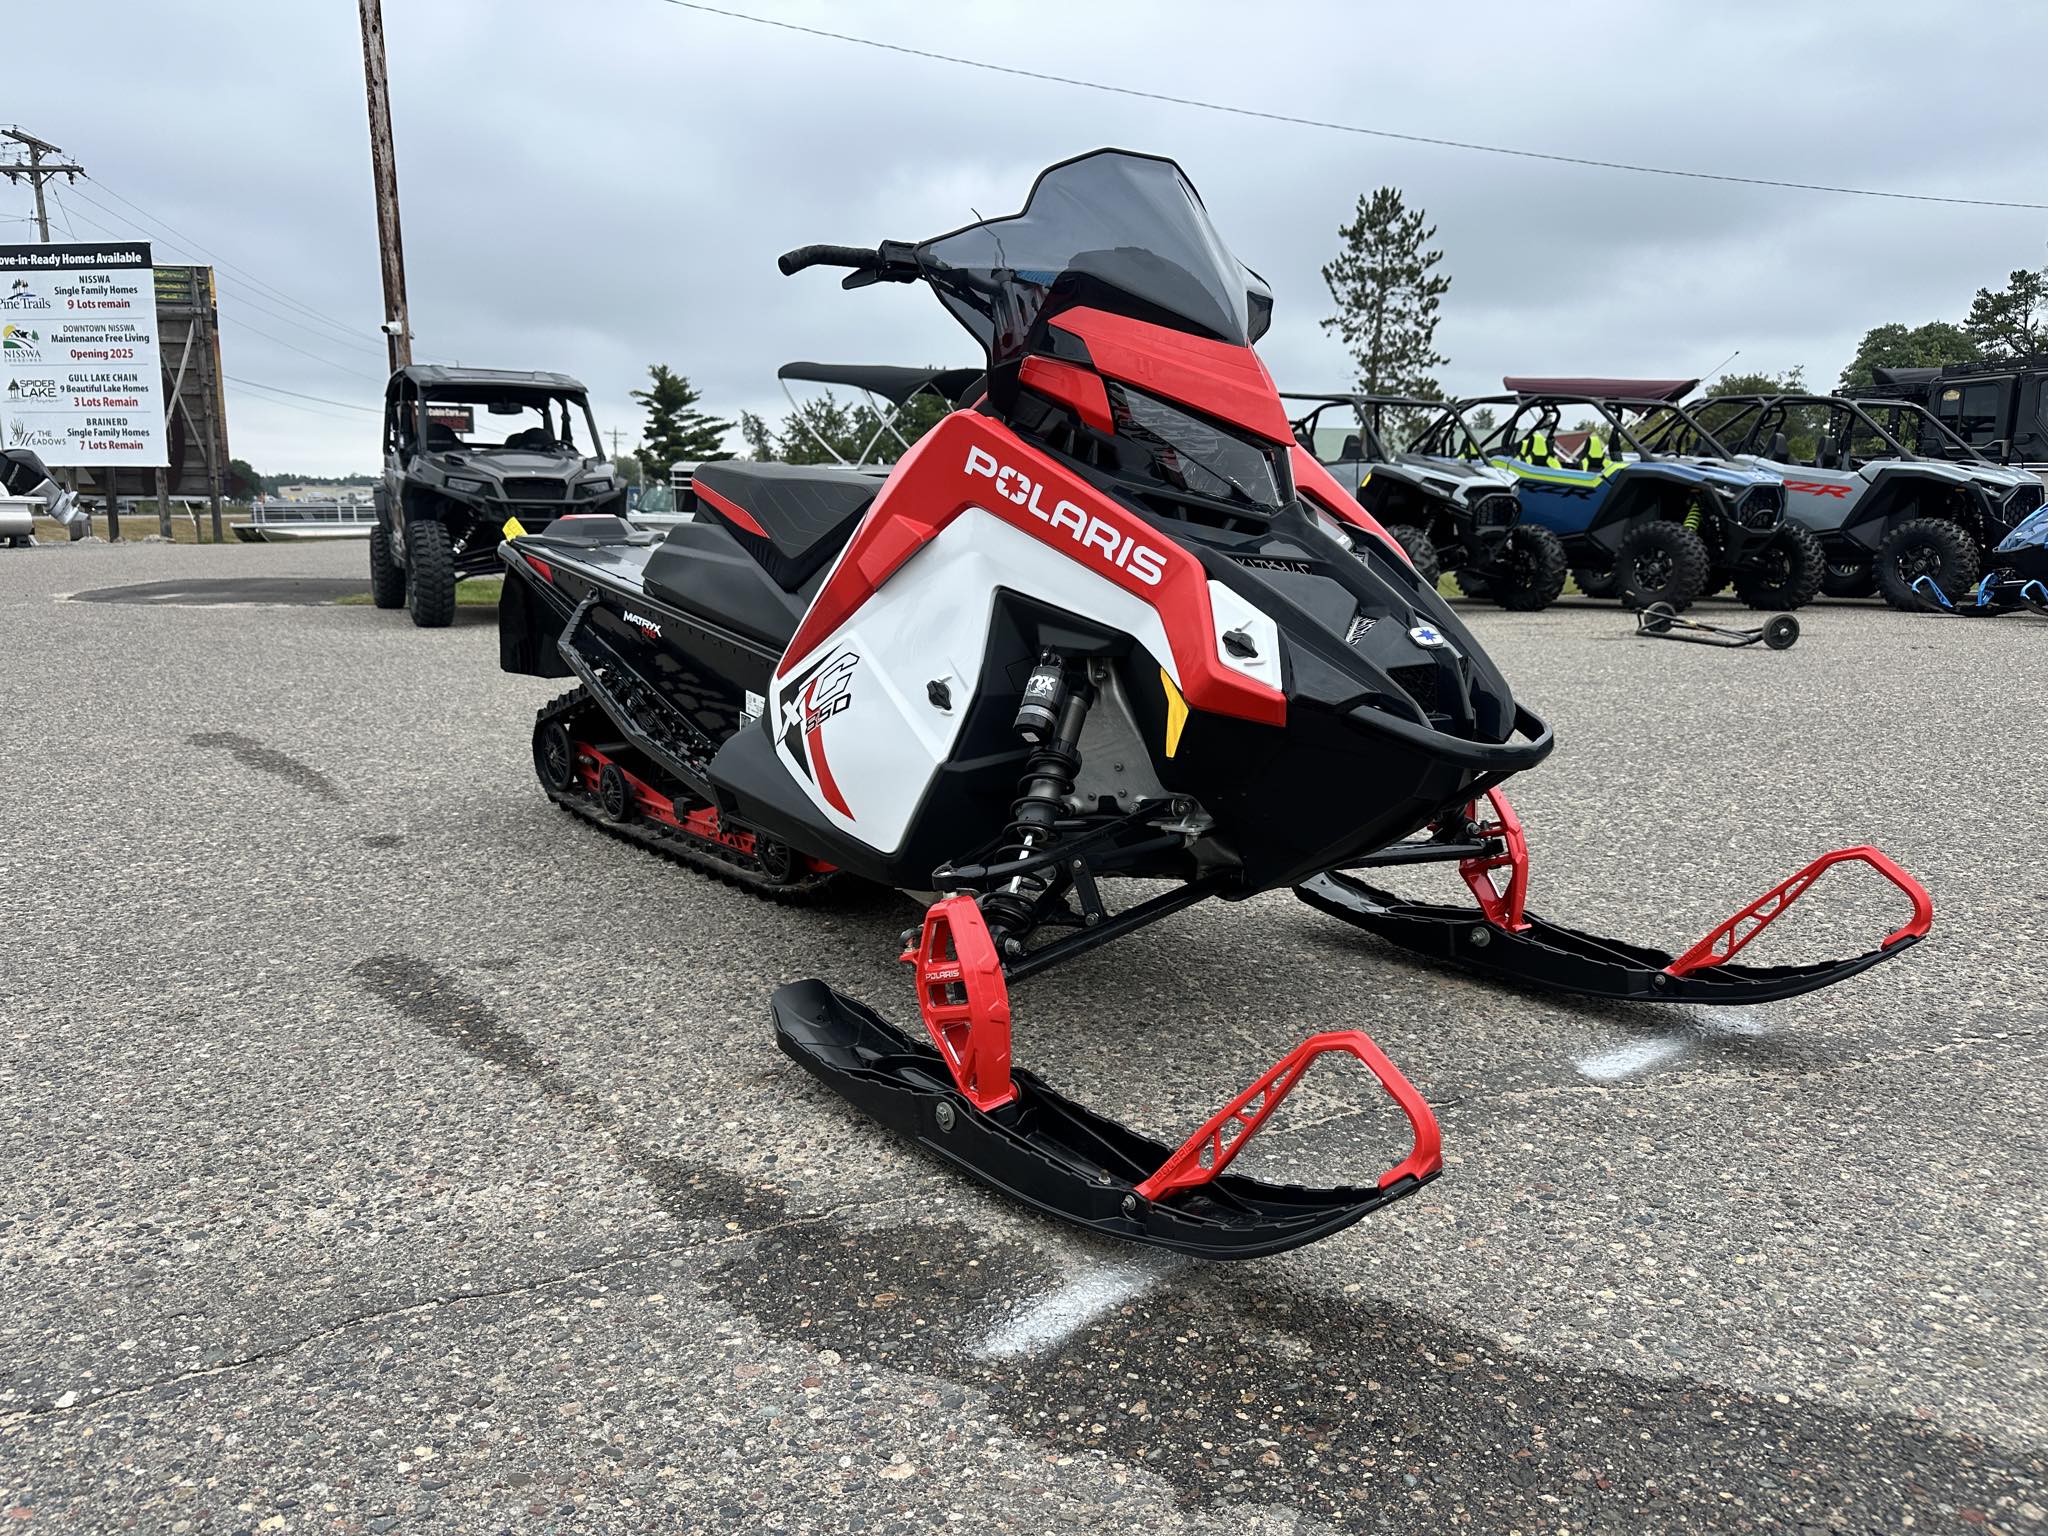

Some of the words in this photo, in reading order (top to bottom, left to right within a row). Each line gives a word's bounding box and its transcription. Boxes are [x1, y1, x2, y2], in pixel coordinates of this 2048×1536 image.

[0, 253, 60, 267] ove-in-Ready
[62, 253, 95, 265] Homes
[97, 252, 142, 264] Available
[79, 275, 111, 284] NISSWA
[54, 286, 80, 297] Single
[81, 286, 108, 297] Family
[110, 285, 138, 295] Homes
[20, 298, 51, 310] Trails
[67, 300, 74, 309] 9
[77, 299, 96, 309] Lots
[98, 299, 130, 309] remain
[63, 324, 106, 333] DOWNTOWN
[108, 324, 136, 332] NISSWA
[51, 334, 103, 343] Maintenance
[105, 333, 123, 343] Free
[125, 333, 150, 344] Living
[4, 349, 42, 359] NISSWA
[70, 348, 109, 360] Opening
[110, 348, 134, 359] 2025
[68, 373, 88, 382] GULL
[90, 373, 111, 382] LAKE
[112, 373, 138, 382] CHAIN
[19, 379, 56, 388] SPIDER
[60, 384, 65, 393] 9
[66, 384, 102, 393] Beautiful
[103, 383, 121, 393] Lake
[122, 384, 149, 393] Homes
[21, 387, 57, 398] LAKE
[74, 397, 80, 407] 3
[81, 396, 101, 407] Lots
[103, 396, 138, 407] Remain
[86, 418, 128, 426] BRAINERD
[67, 428, 93, 439] Single
[94, 428, 120, 439] Family
[122, 428, 150, 437] Homes
[79, 441, 85, 450] 7
[88, 440, 107, 450] Lots
[109, 440, 144, 450] Remain
[1783, 479, 1854, 499] ZR
[964, 445, 1168, 586] POLARIS
[623, 610, 662, 638] MATRYX
[925, 968, 960, 981] POLARIS
